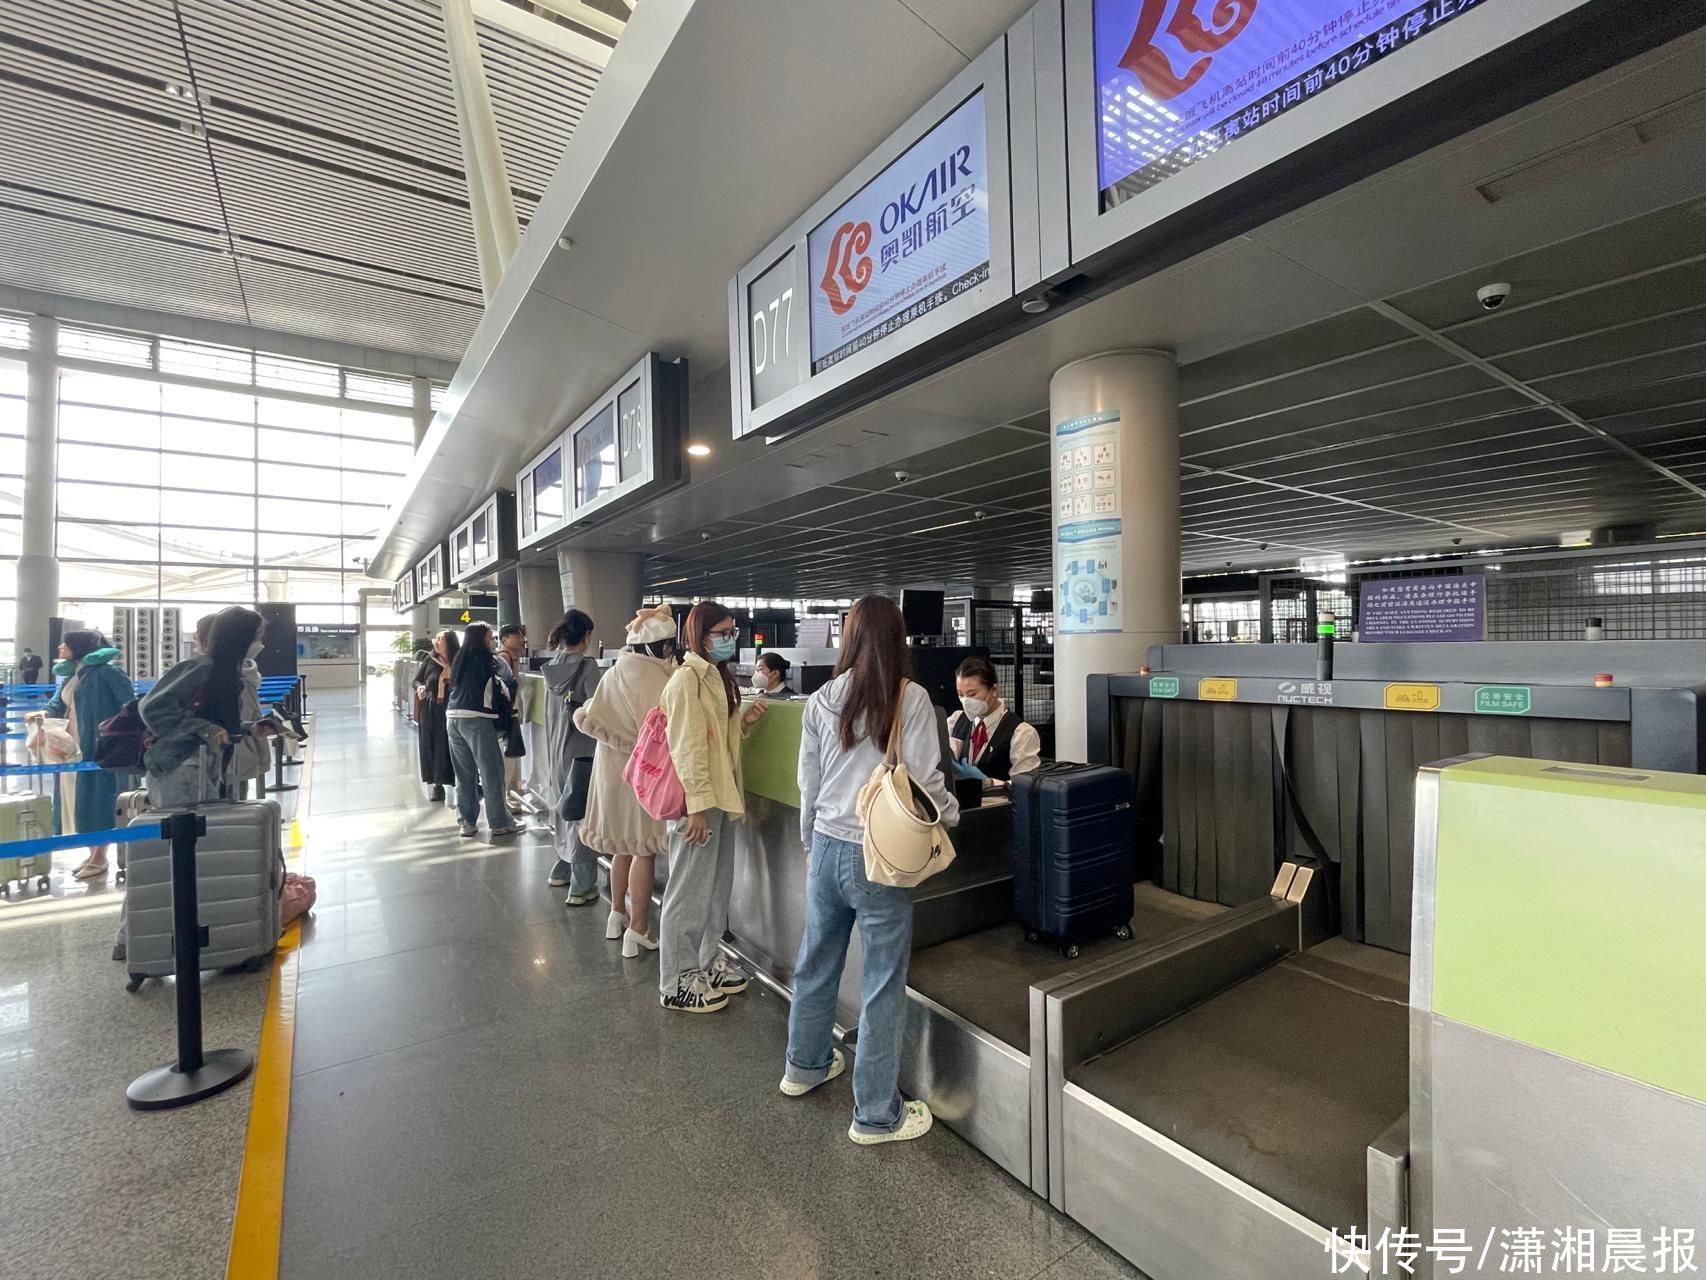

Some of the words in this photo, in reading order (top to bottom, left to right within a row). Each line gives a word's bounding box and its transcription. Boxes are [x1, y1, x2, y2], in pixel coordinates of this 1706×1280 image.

[1229, 83, 1254, 104] closed
[1268, 53, 1305, 79] minutes
[1306, 35, 1338, 57] before
[1339, 7, 1385, 37] schedule
[880, 145, 973, 235] OKAIR
[880, 183, 976, 274] 奥凯航空
[753, 288, 793, 376] D77
[622, 403, 642, 458] D78
[460, 610, 471, 623] 4
[1300, 682, 1333, 695] 威视
[1479, 700, 1500, 708] FILM
[1501, 700, 1524, 709] SAFE
